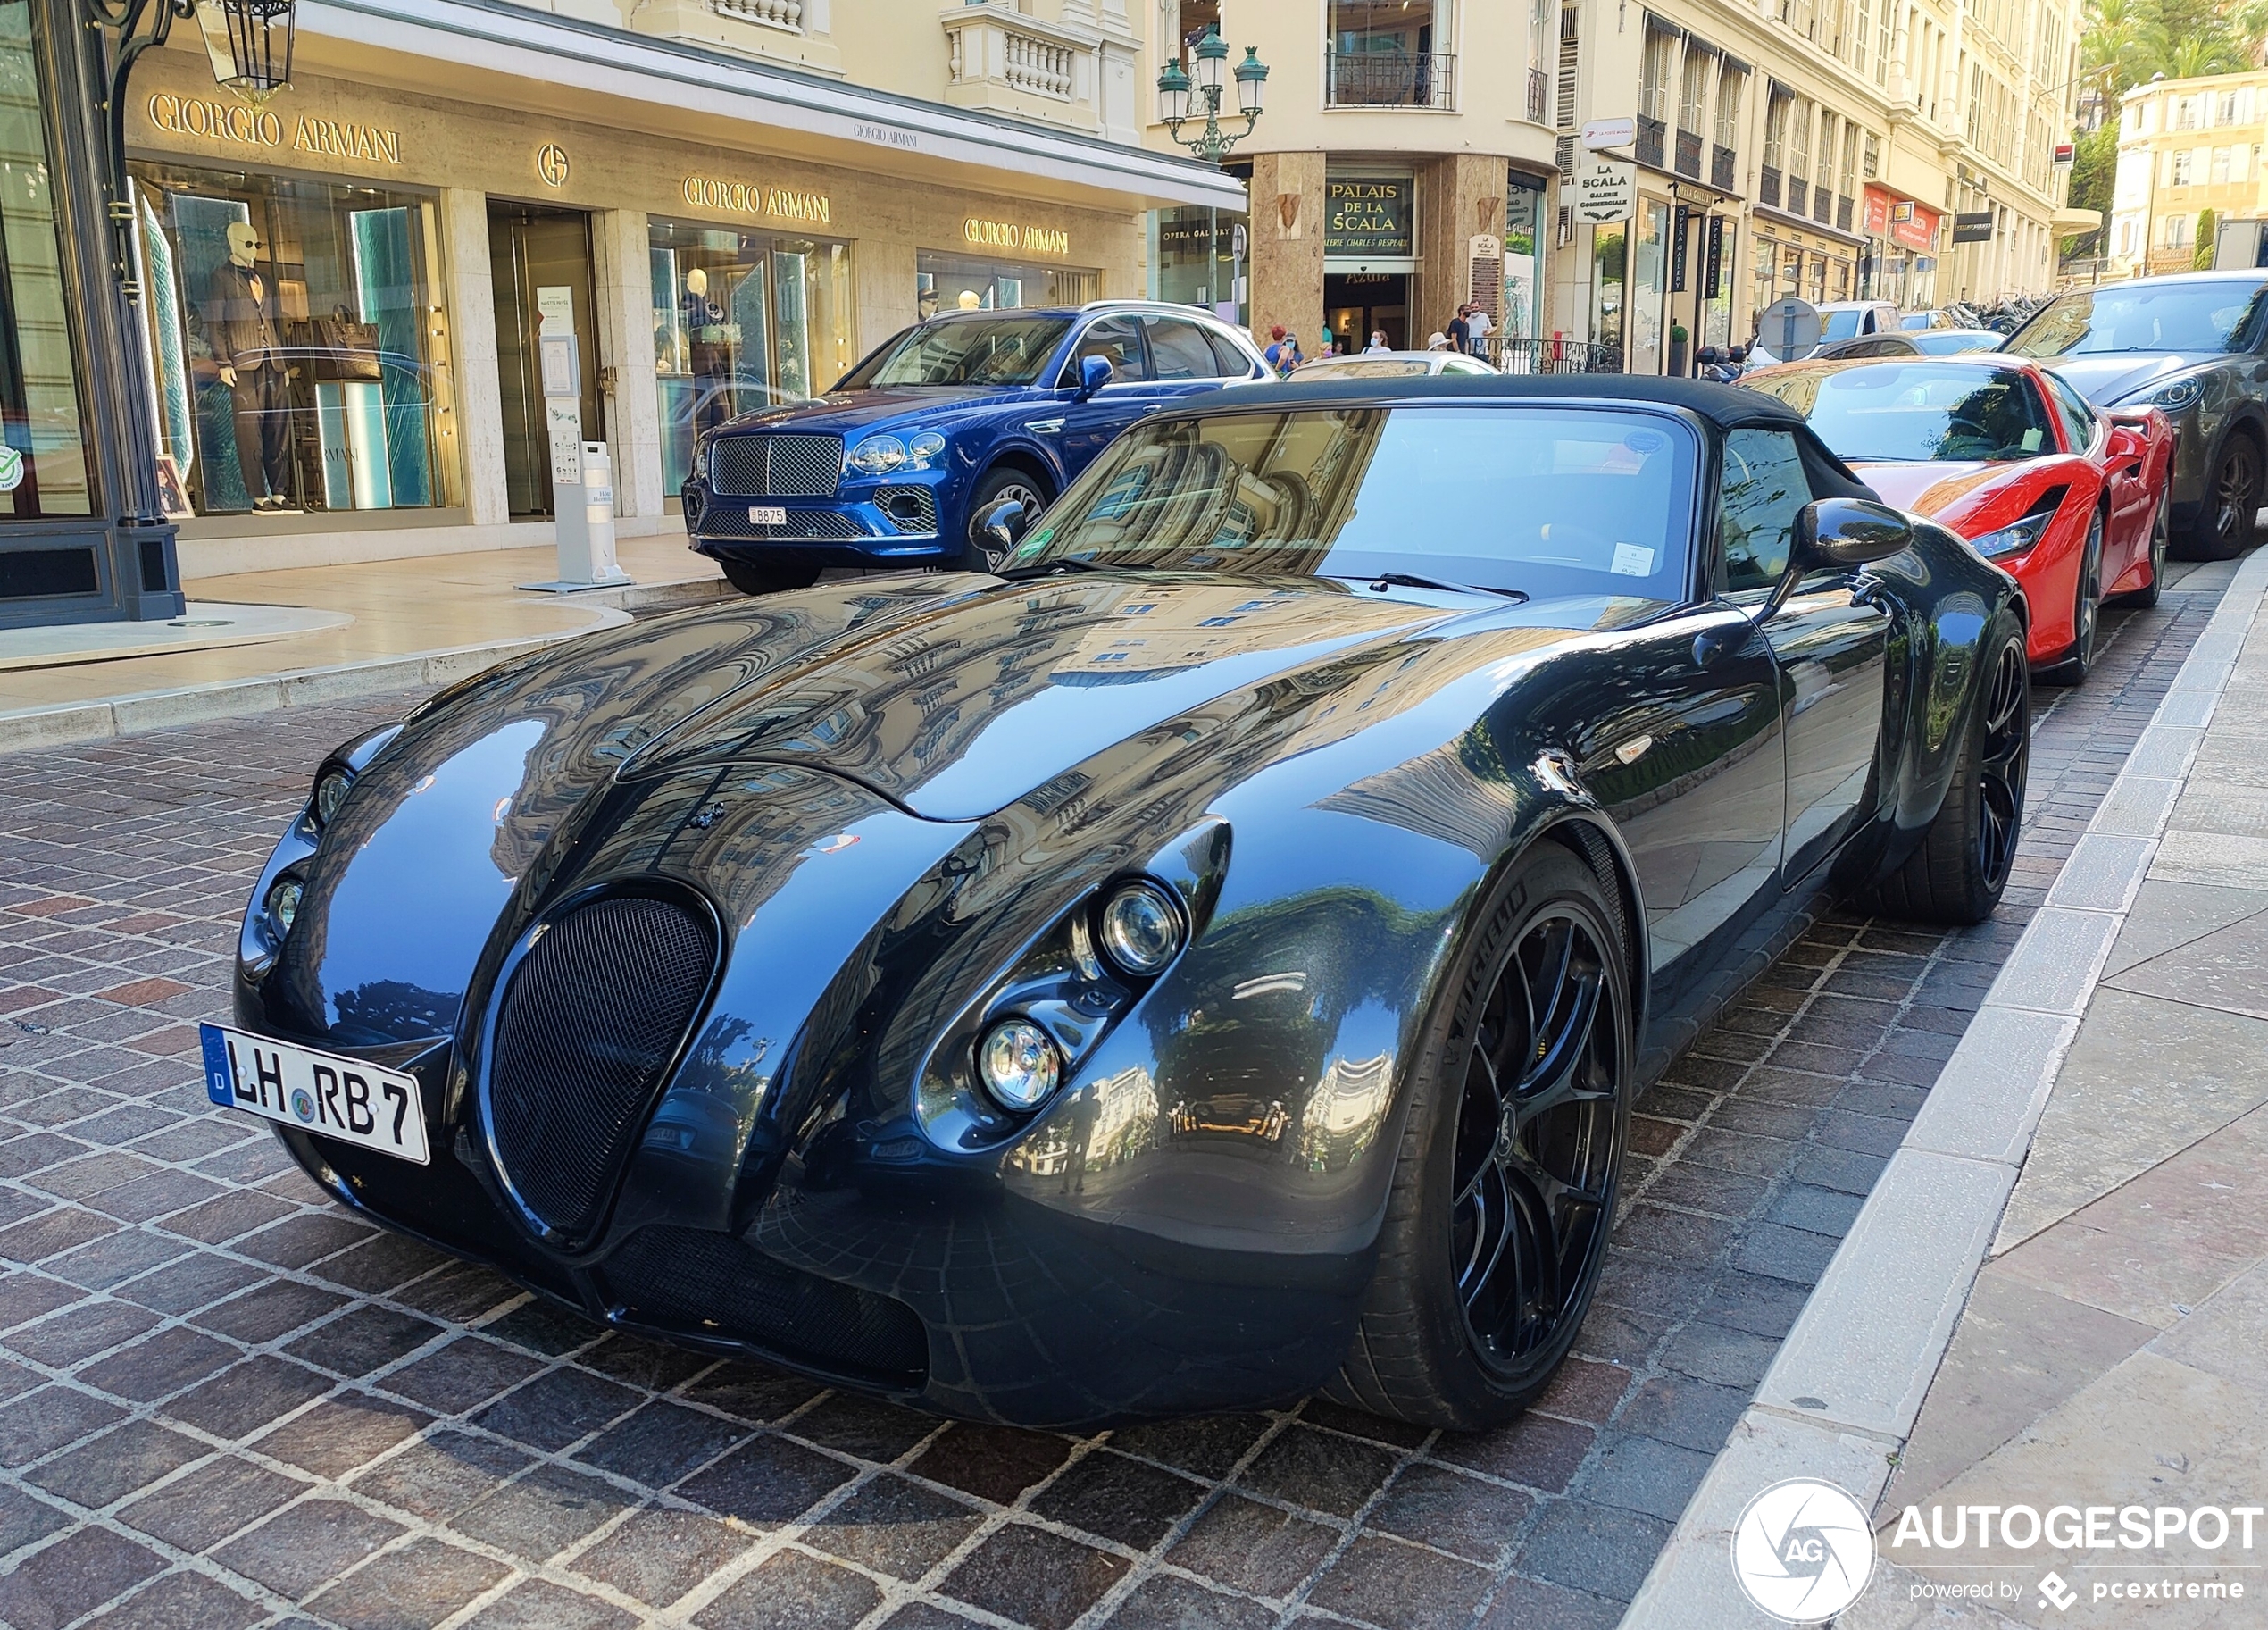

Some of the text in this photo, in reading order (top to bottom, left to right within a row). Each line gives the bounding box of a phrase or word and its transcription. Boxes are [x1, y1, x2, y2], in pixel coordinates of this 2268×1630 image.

[148, 94, 402, 164] GIORGIO ARMANI
[853, 124, 917, 147] GIORGIO ARMANI
[1597, 165, 1613, 174] LA
[1582, 176, 1627, 188] SCALA
[683, 176, 830, 222] GIORGIO ARMANI
[1331, 184, 1397, 198] PALAIS
[1589, 191, 1618, 199] GALERIE
[1344, 202, 1384, 213] DE LA
[1332, 216, 1396, 230] SCALA
[1677, 209, 1686, 241] OPERA
[963, 218, 1069, 254] GIORGIO ARMANI
[1163, 228, 1230, 241] OPERA GALERY
[1323, 238, 1345, 247] ALERIE
[1347, 238, 1376, 247] CHARLES
[1712, 219, 1721, 250] OPERA
[1675, 245, 1683, 288] GALLERY
[1709, 254, 1717, 295] GALLERY
[323, 447, 359, 462] RMANI
[757, 510, 784, 522] B875
[213, 1072, 225, 1091] D
[227, 1040, 287, 1113] LH
